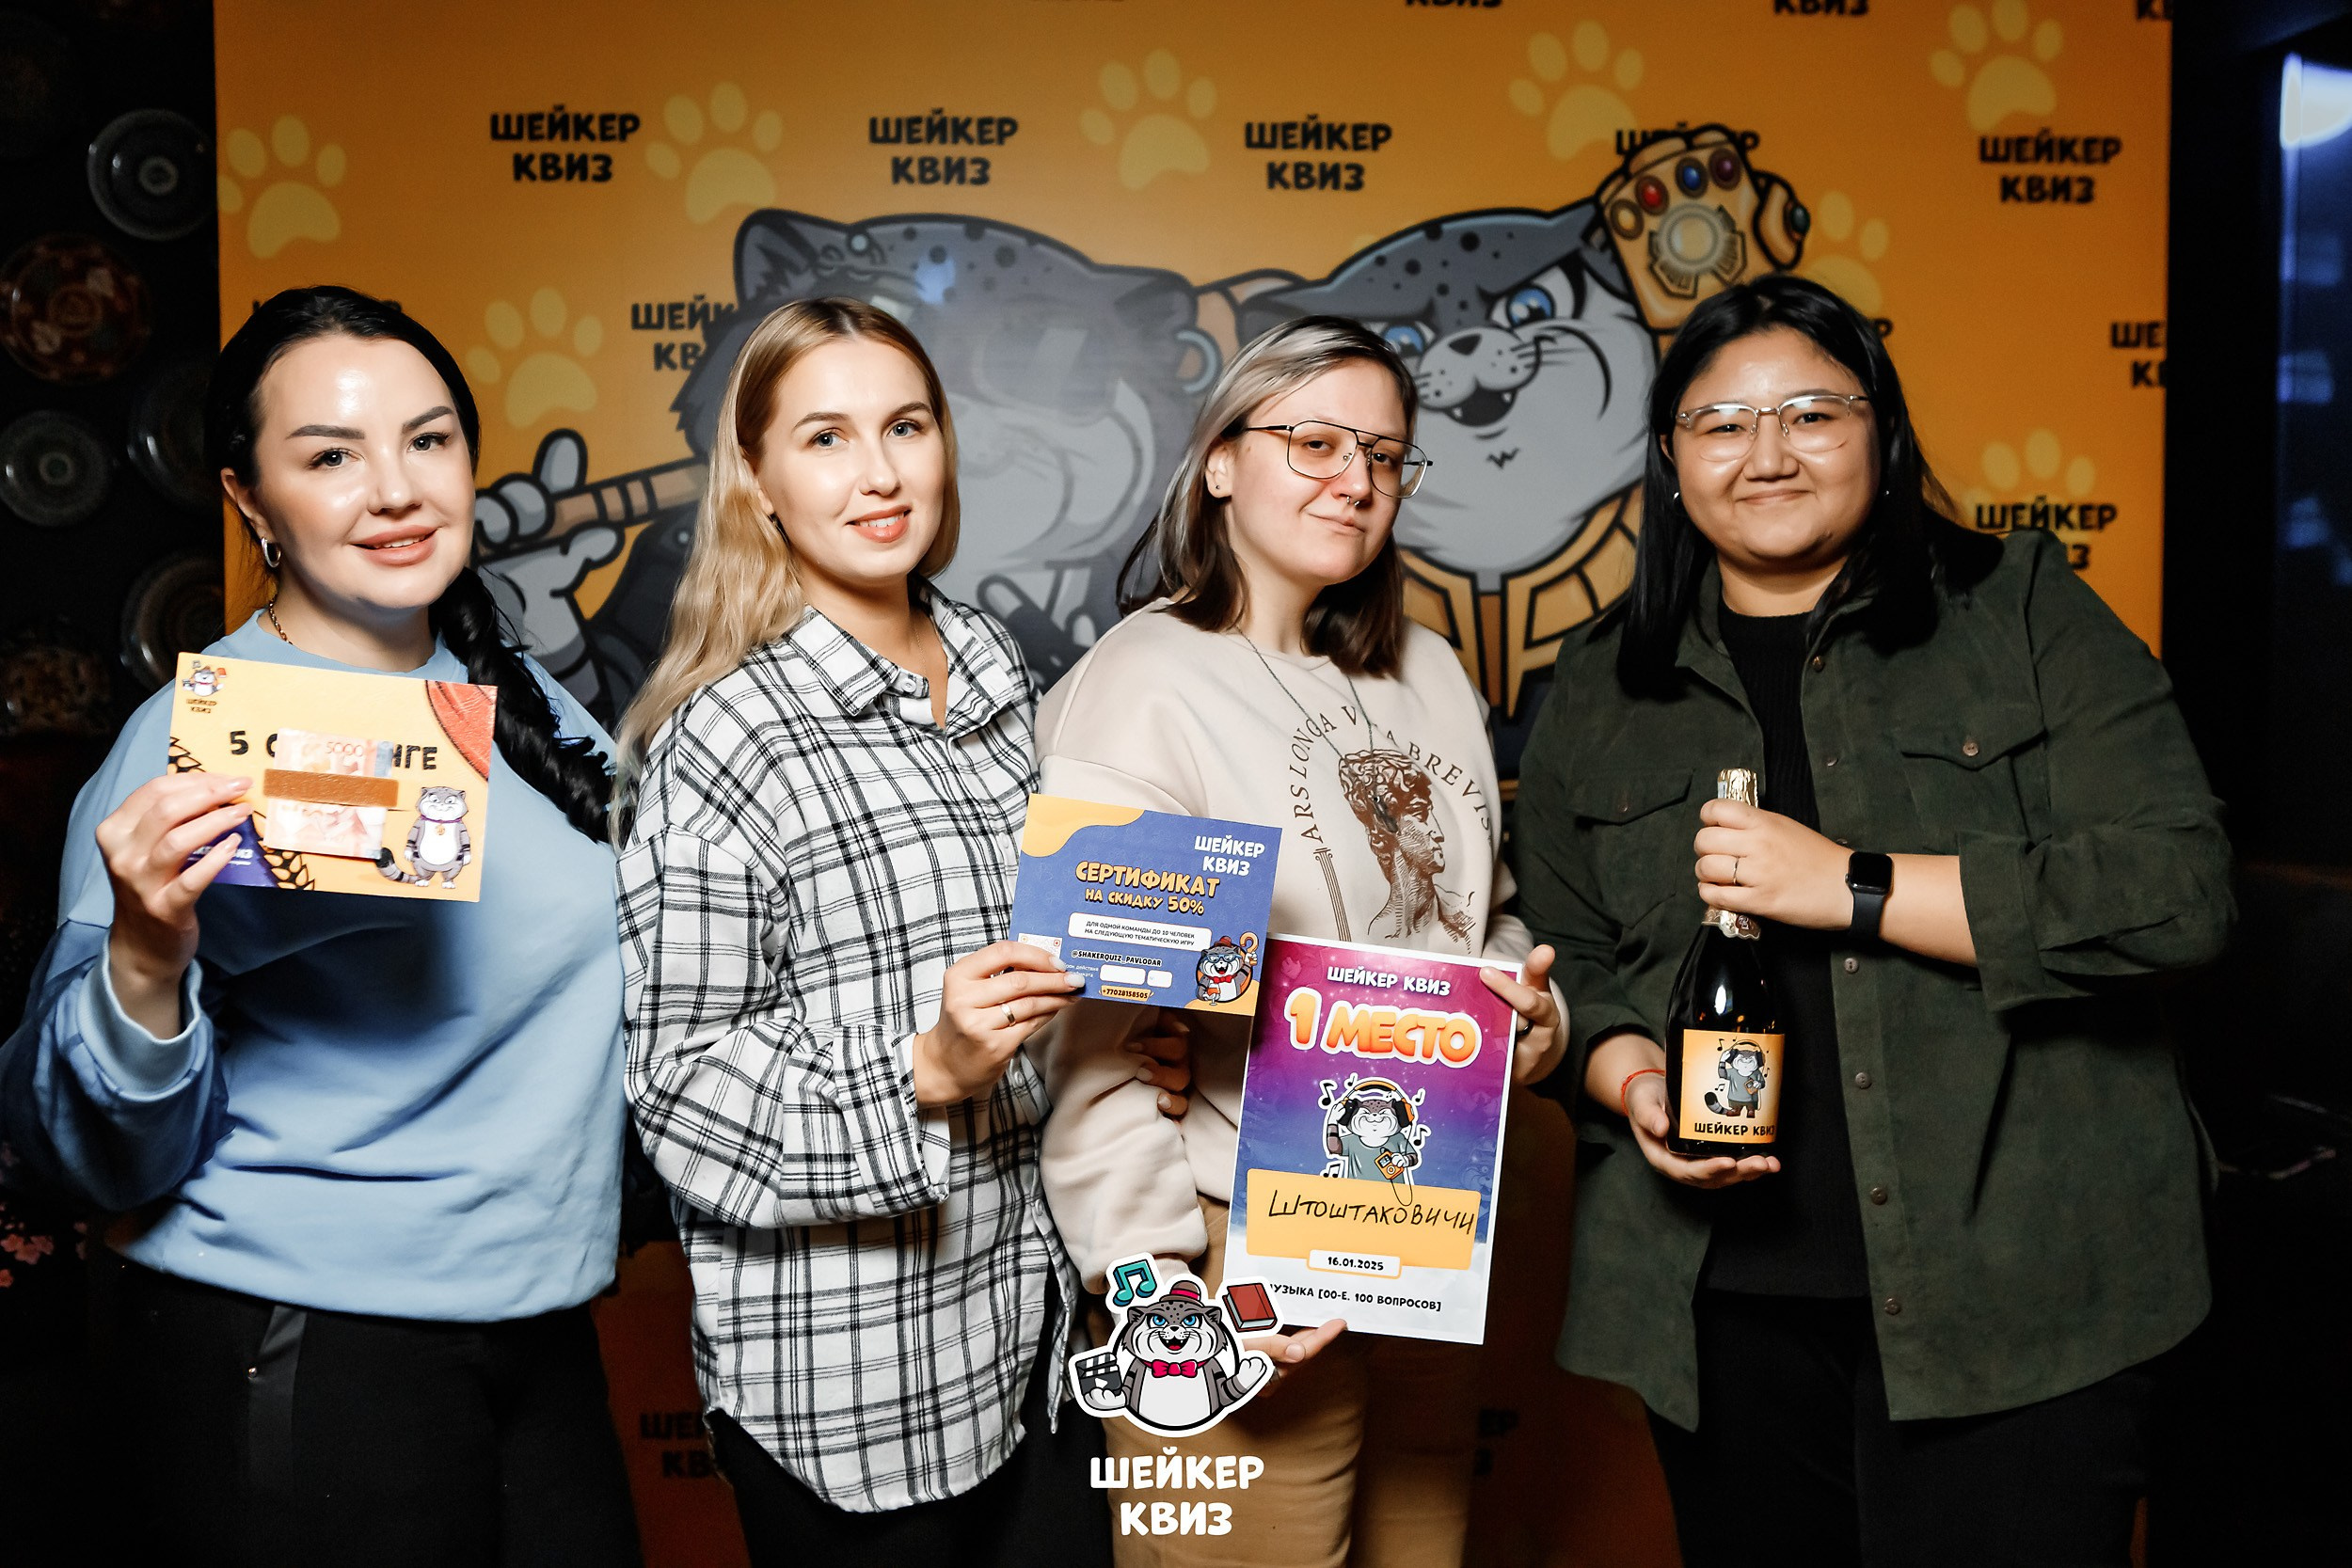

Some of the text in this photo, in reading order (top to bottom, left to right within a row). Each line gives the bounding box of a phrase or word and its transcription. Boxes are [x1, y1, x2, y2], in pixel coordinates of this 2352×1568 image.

[490, 105, 642, 143] ШЕЙКЕР
[869, 109, 1019, 146] ШЕЙКЕР
[1245, 115, 1392, 151] ШЕЙКЕР
[1979, 128, 2122, 166] ШЕЙКЕР
[513, 152, 613, 182] КВИЗ
[891, 156, 991, 186] КВИЗ
[1266, 162, 1365, 192] КВИЗ
[1999, 176, 2095, 205] КВИЗ
[631, 293, 737, 330] ШЕЙК
[654, 342, 706, 372] КВ
[1977, 495, 2118, 531] ШЕЙКЕР
[230, 730, 249, 755] 5
[325, 740, 365, 757] 5000
[1289, 712, 1338, 780] LONGA
[1408, 741, 1490, 832] BREVIS
[1290, 784, 1324, 844] ARS
[1194, 834, 1265, 859] ШЕЙКЕР
[1075, 861, 1220, 898] СЕРТИФИКАТ
[1202, 855, 1251, 877] КВИЗ
[1085, 888, 1205, 916] НА СКИДКУ 50%
[1094, 929, 1134, 940] СЛЕДУЮЩУЮ
[1135, 934, 1179, 944] ТЕМАТИЧЕСКУЮ
[1100, 922, 1120, 930] ОДНОЙ
[1121, 925, 1152, 934] КОМАНДЫ
[1169, 930, 1195, 939] ЧЕЛОВЕК
[1071, 950, 1162, 967] @SHAKERQUIZ_PAVLODAR
[1327, 966, 1452, 996] ШЕЙКЕР КВИЗ
[1288, 990, 1478, 1064] 1 МЕСТО
[1694, 1121, 1749, 1136] ШЕЙКЕР
[1268, 1189, 1475, 1235] ШТОШТАКОВИЧИ
[1327, 1256, 1384, 1271] 16.01.2025
[1270, 1283, 1314, 1297] УЗЫКА
[1355, 1292, 1374, 1304] 100
[1377, 1295, 1441, 1312] ВОПРОСОВ]
